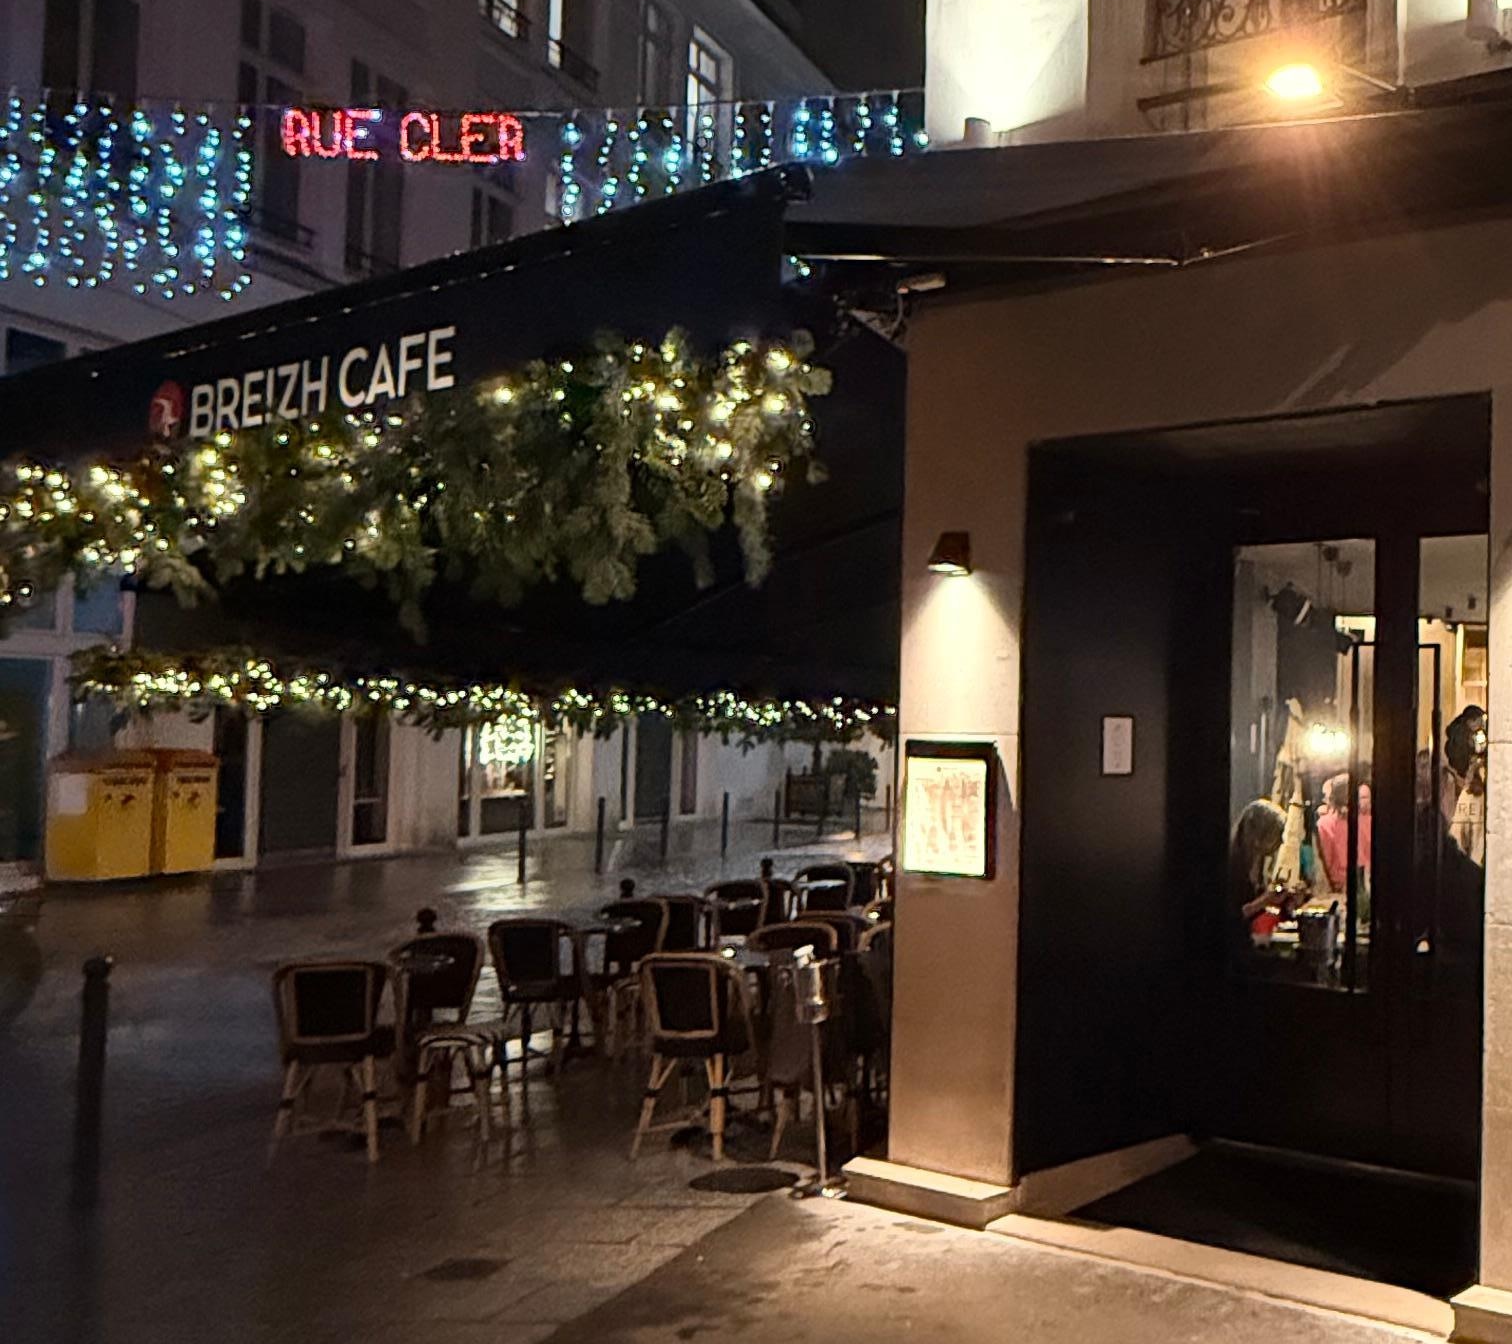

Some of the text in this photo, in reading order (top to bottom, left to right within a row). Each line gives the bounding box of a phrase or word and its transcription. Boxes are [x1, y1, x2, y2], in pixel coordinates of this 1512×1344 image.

[284, 108, 526, 161] RUE CLER
[338, 325, 457, 408] CAFE
